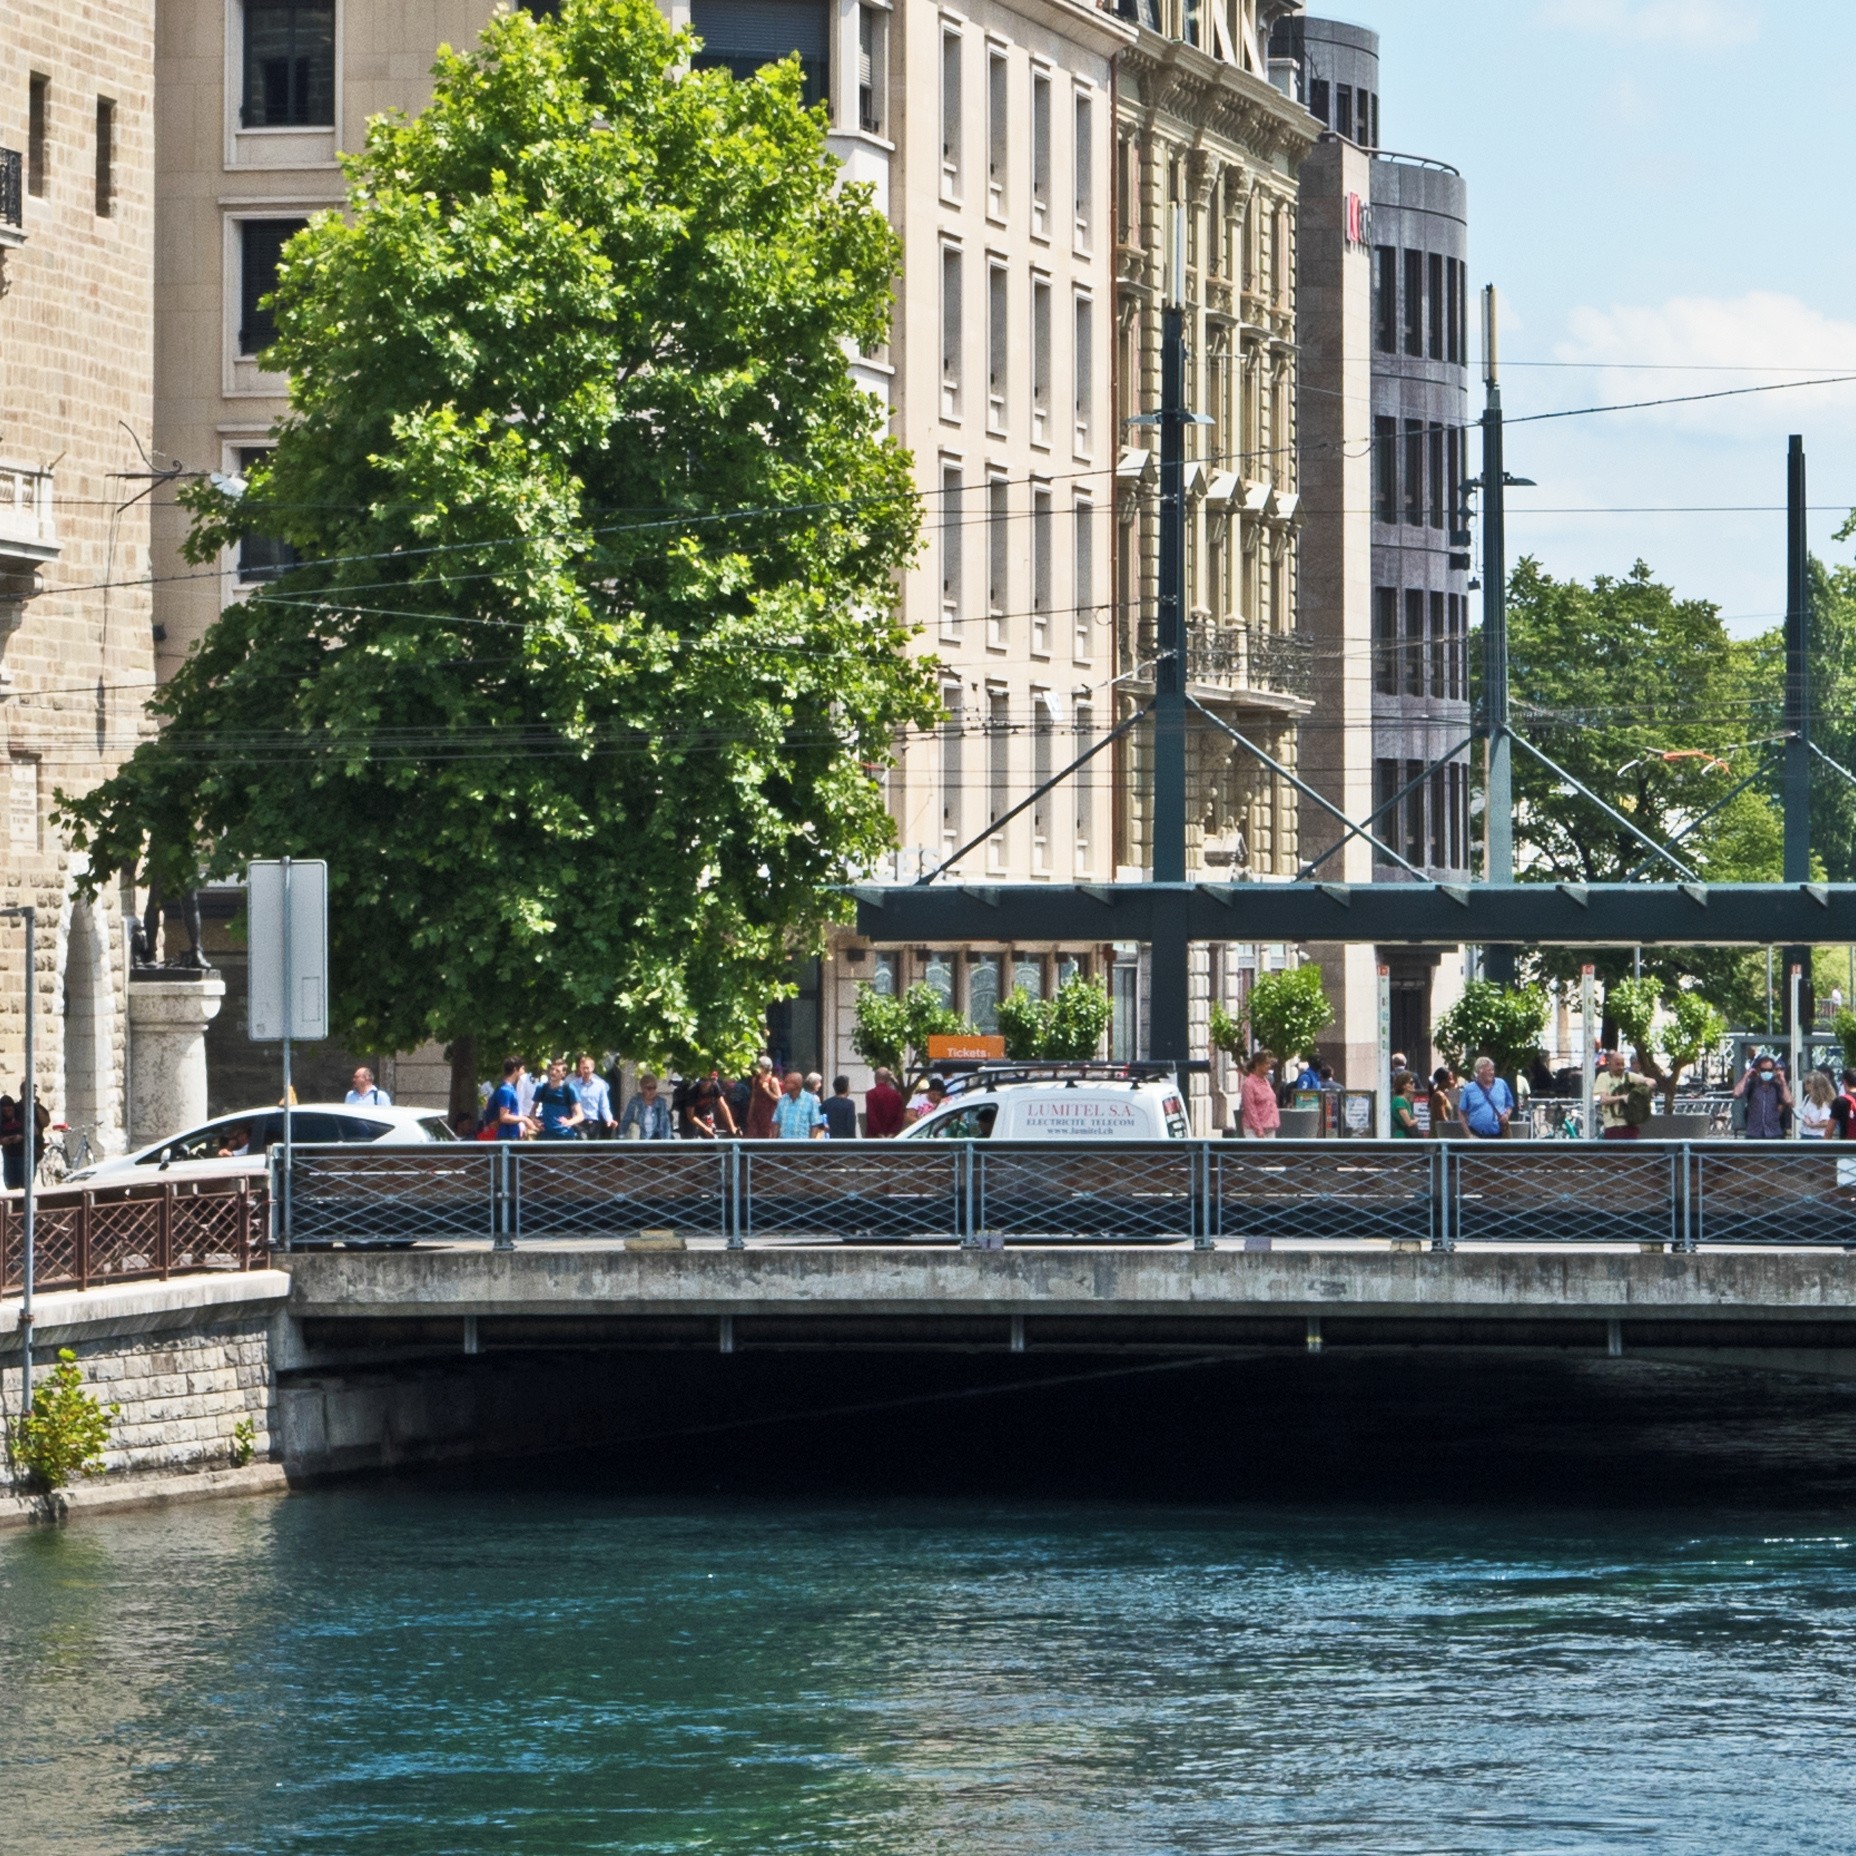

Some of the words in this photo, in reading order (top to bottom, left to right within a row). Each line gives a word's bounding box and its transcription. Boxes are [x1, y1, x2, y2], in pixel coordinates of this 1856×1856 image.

[947, 1047, 987, 1058] Tickets
[1027, 1104, 1105, 1117] LUMITEL
[1108, 1104, 1135, 1117] S.A.
[1091, 1119, 1135, 1127] TELECOM
